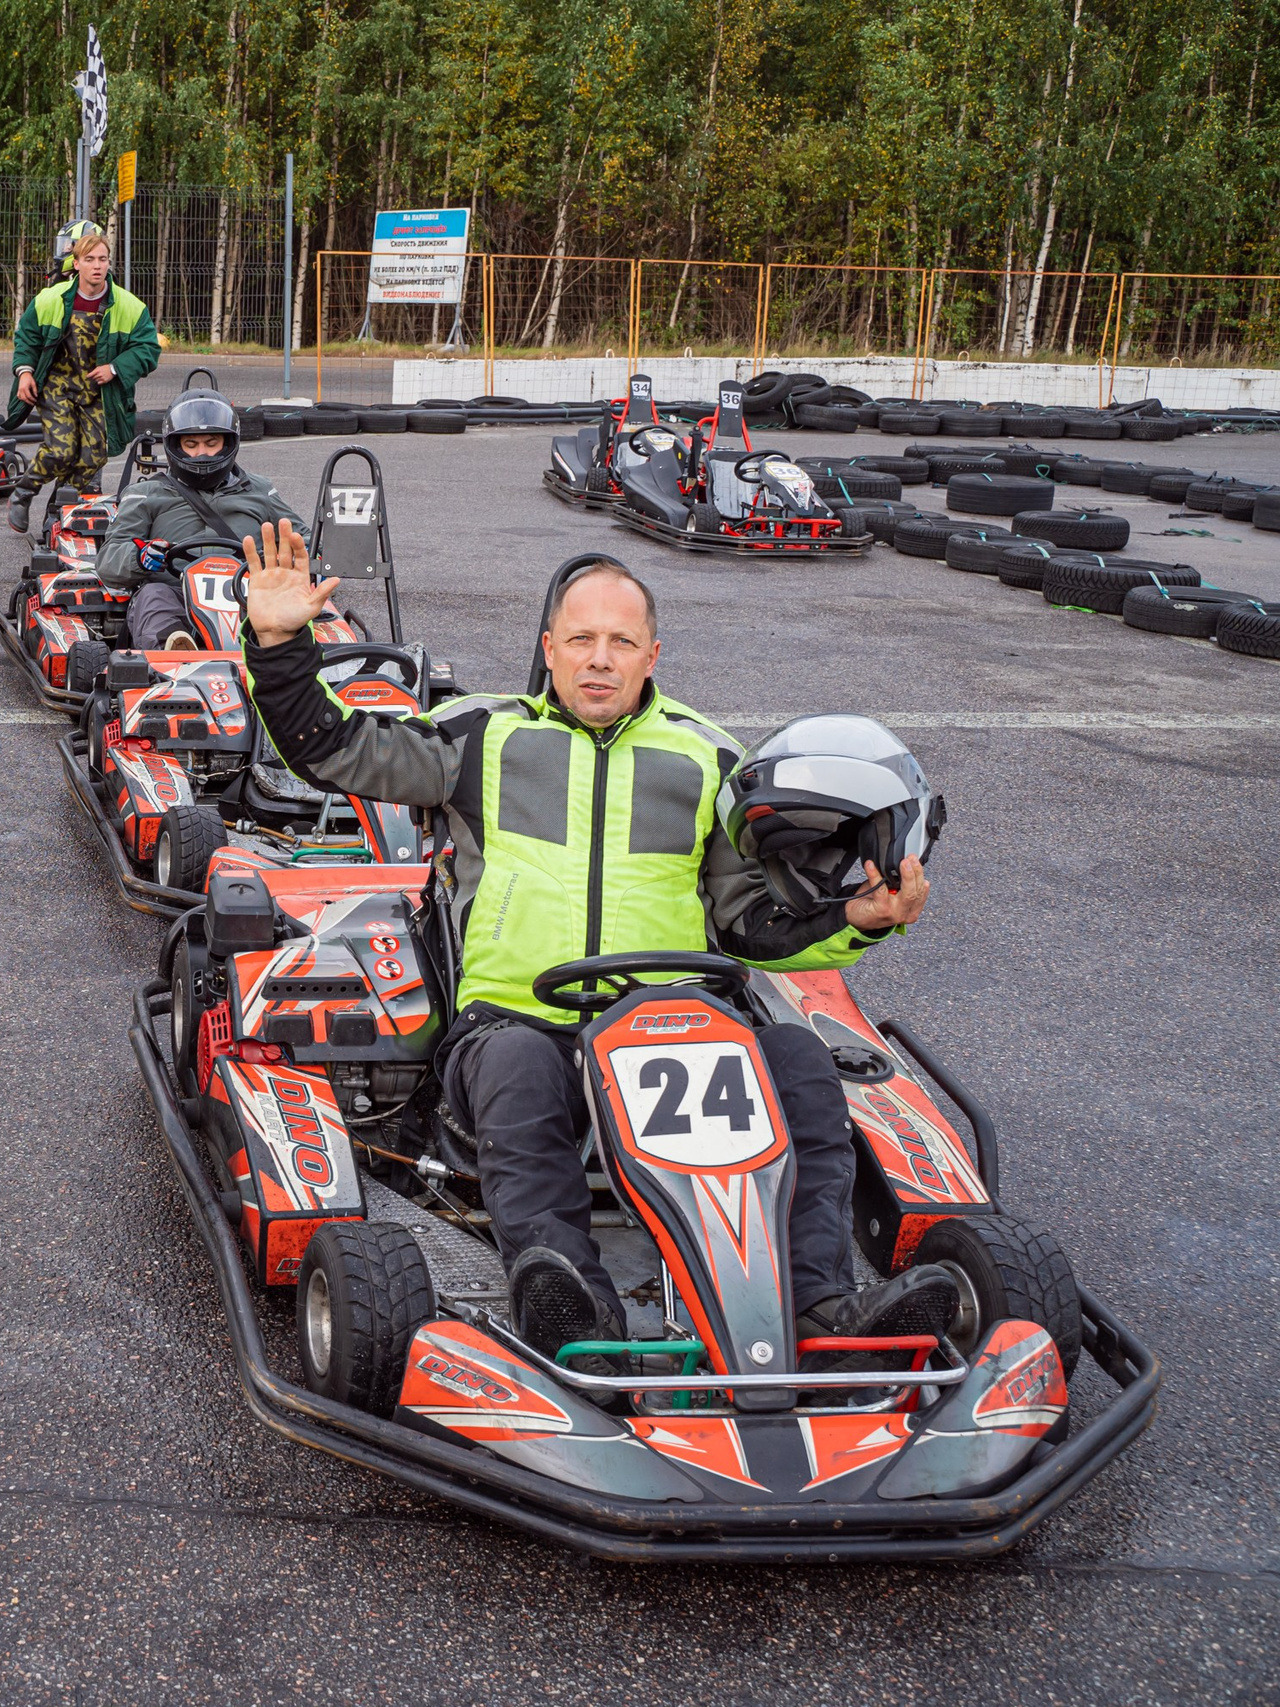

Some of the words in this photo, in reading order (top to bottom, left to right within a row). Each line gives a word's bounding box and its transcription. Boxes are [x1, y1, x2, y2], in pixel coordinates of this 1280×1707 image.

[393, 227, 413, 235] ДРИФТ
[444, 265, 459, 275] ПДД)
[633, 383, 649, 393] 34
[722, 393, 740, 405] 36
[771, 467, 800, 475] 36
[332, 492, 372, 515] 17
[346, 689, 392, 698] DINO
[139, 756, 179, 802] DINO
[492, 915, 505, 940] BMW
[499, 873, 519, 915] Motorrad
[632, 1013, 710, 1030] DINO
[639, 1055, 755, 1137] 24
[256, 1092, 286, 1146] KART
[268, 1076, 334, 1188] DINO
[864, 1091, 951, 1195] DINO
[418, 1355, 513, 1402] DINO
[1007, 1351, 1055, 1404] DINO
